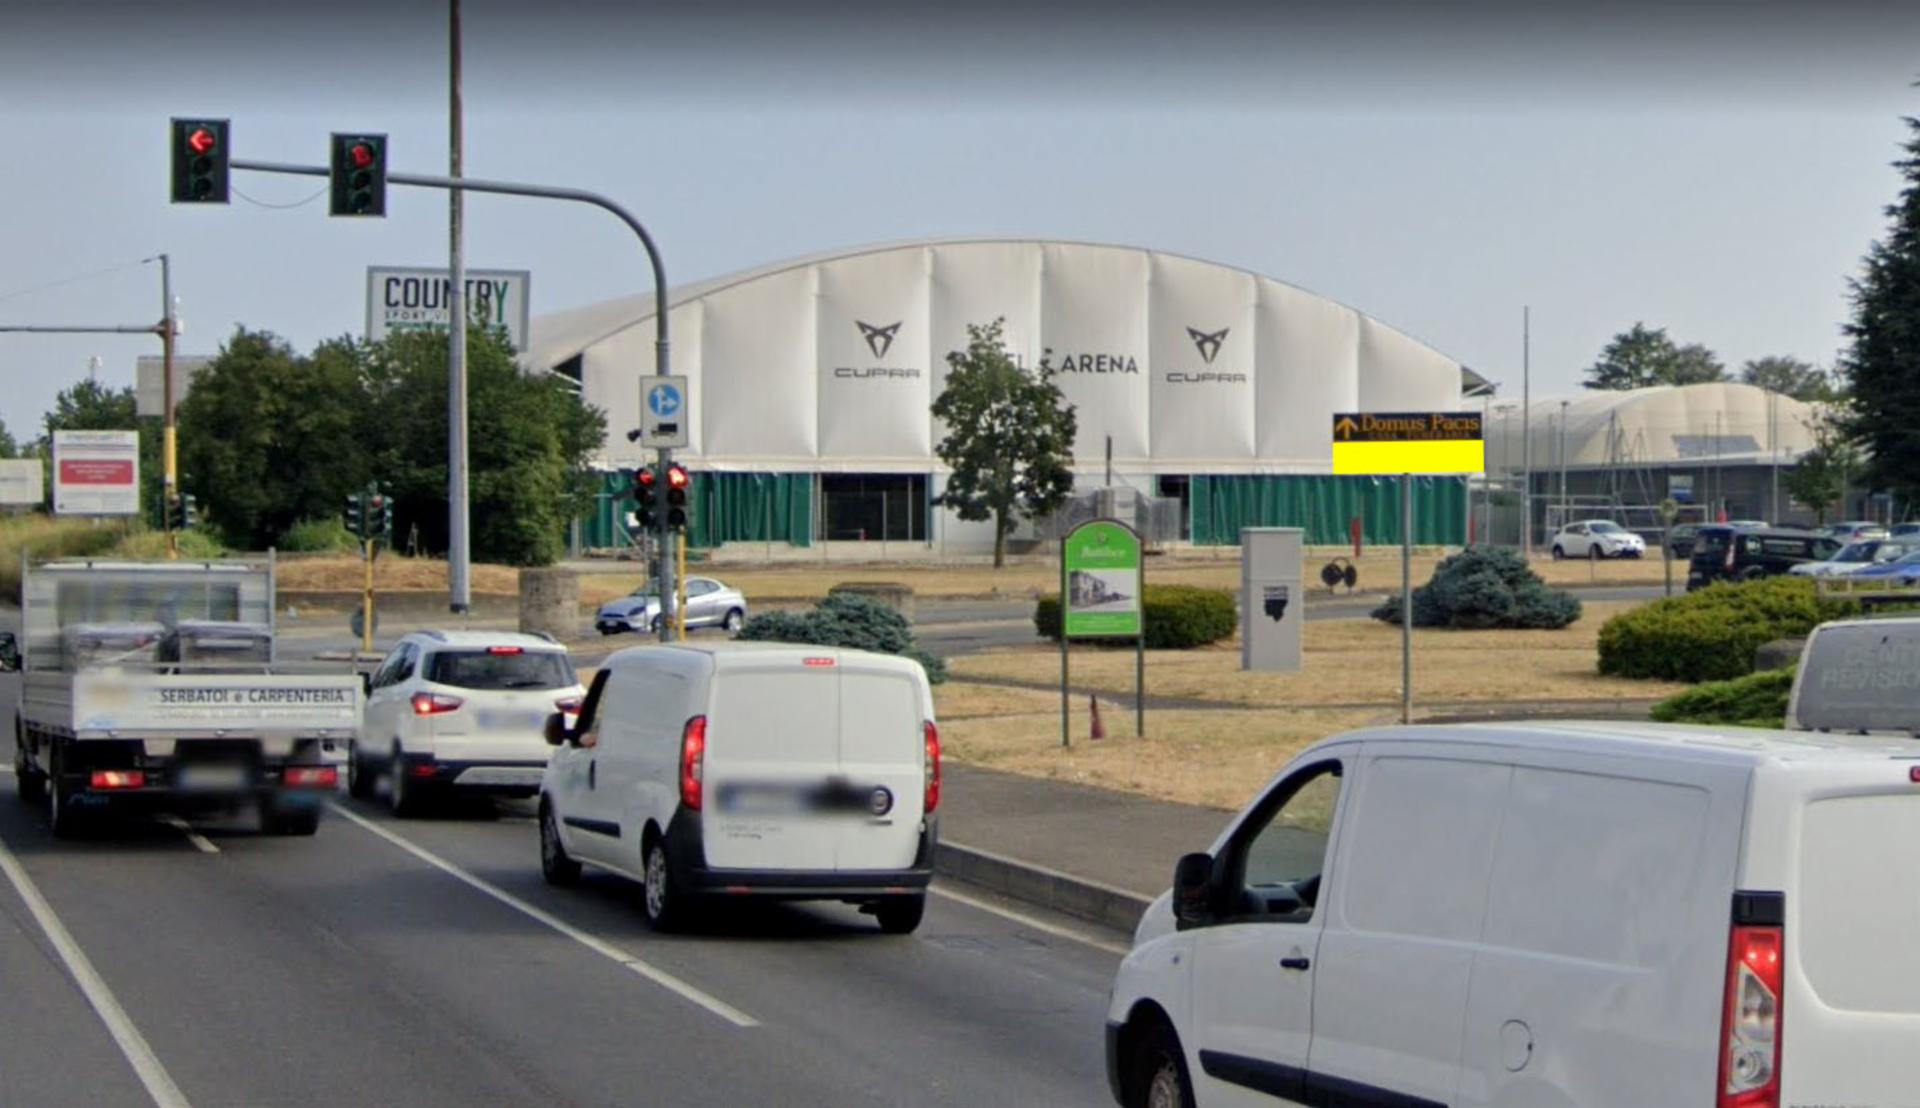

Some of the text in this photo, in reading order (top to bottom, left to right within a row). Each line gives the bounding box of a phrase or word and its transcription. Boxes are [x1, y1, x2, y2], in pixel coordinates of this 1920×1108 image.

[1061, 354, 1139, 375] ARENA
[834, 367, 921, 378] CUPRA
[1166, 372, 1247, 383] CUPRA
[1362, 413, 1479, 431] Domus Pacis
[161, 688, 345, 703] SERBATOI e CARPENTERIA
